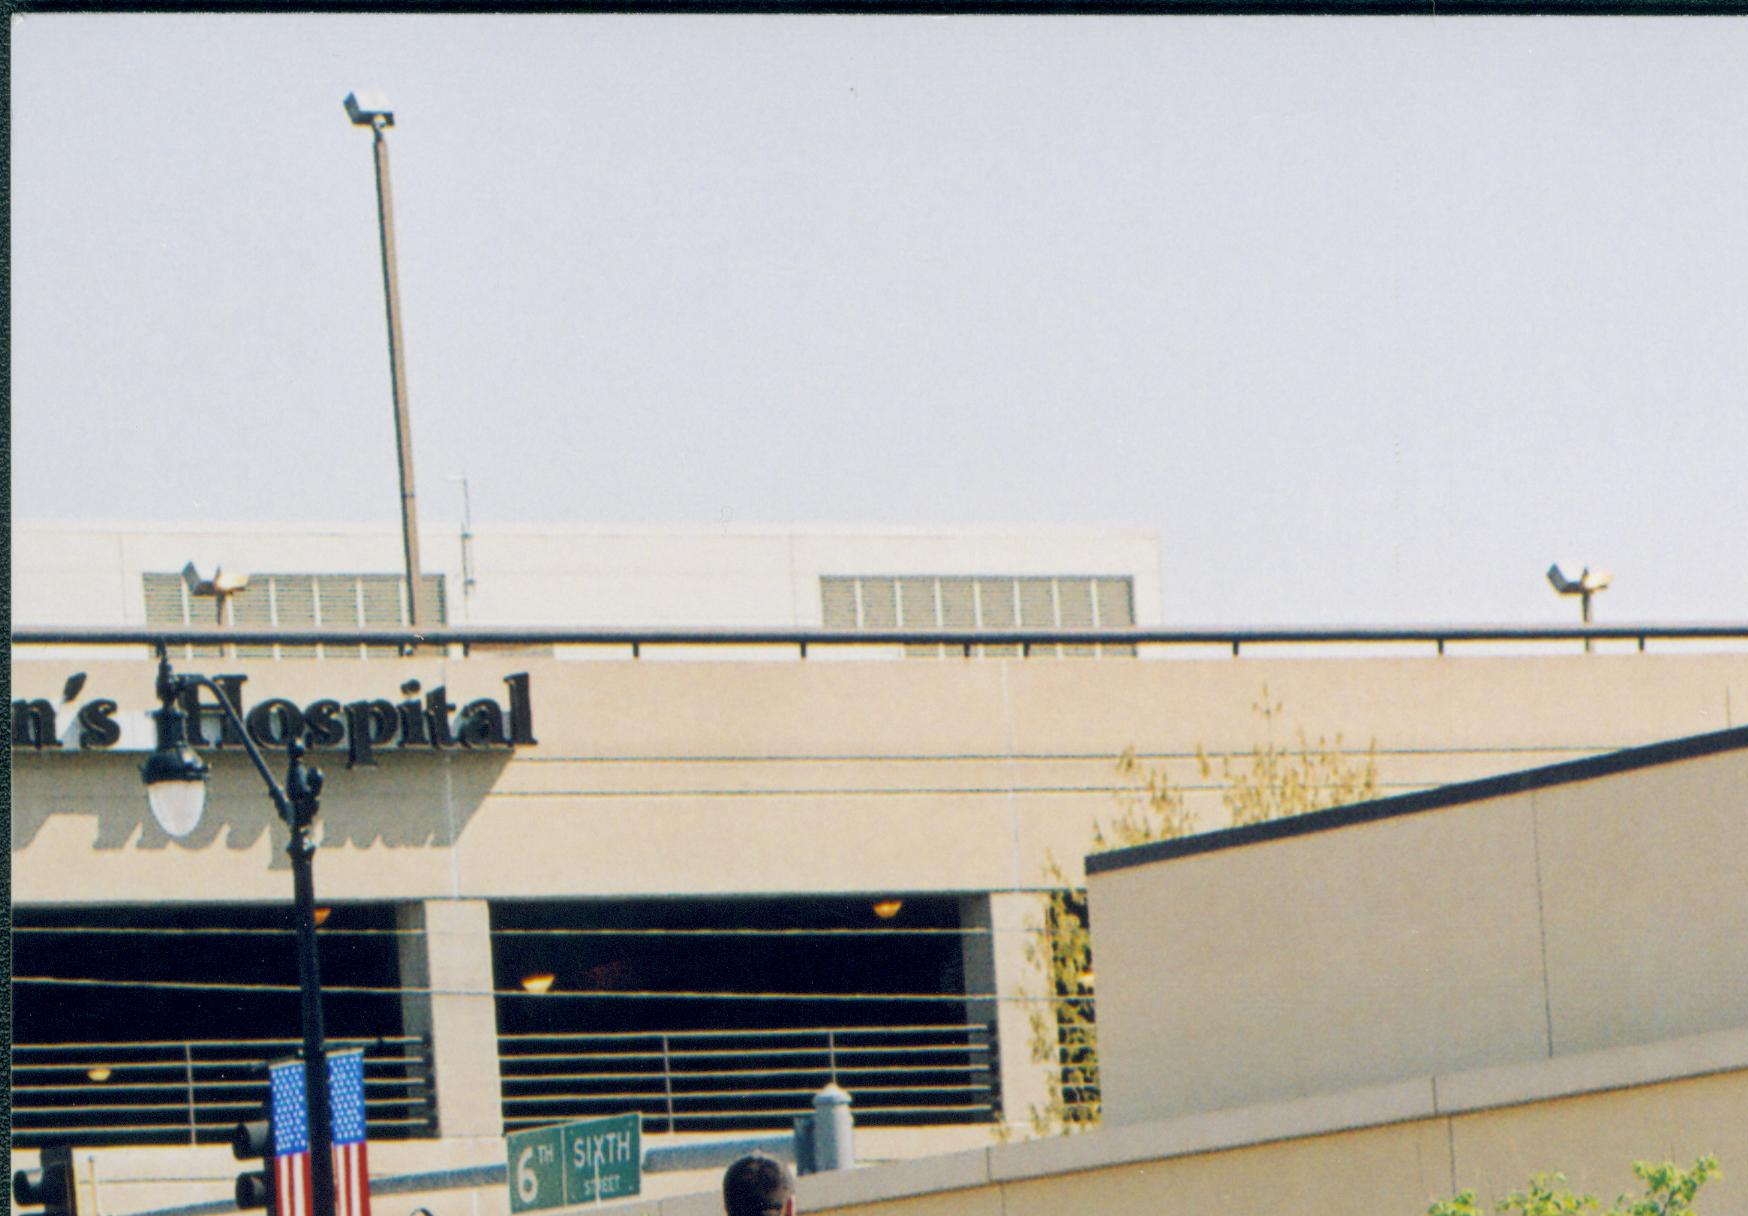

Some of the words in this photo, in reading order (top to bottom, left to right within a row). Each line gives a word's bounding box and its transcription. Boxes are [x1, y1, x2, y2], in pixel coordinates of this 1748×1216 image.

[180, 672, 538, 768] Hospital
[573, 1131, 631, 1168] SIXTH
[583, 1174, 620, 1196] STEET
